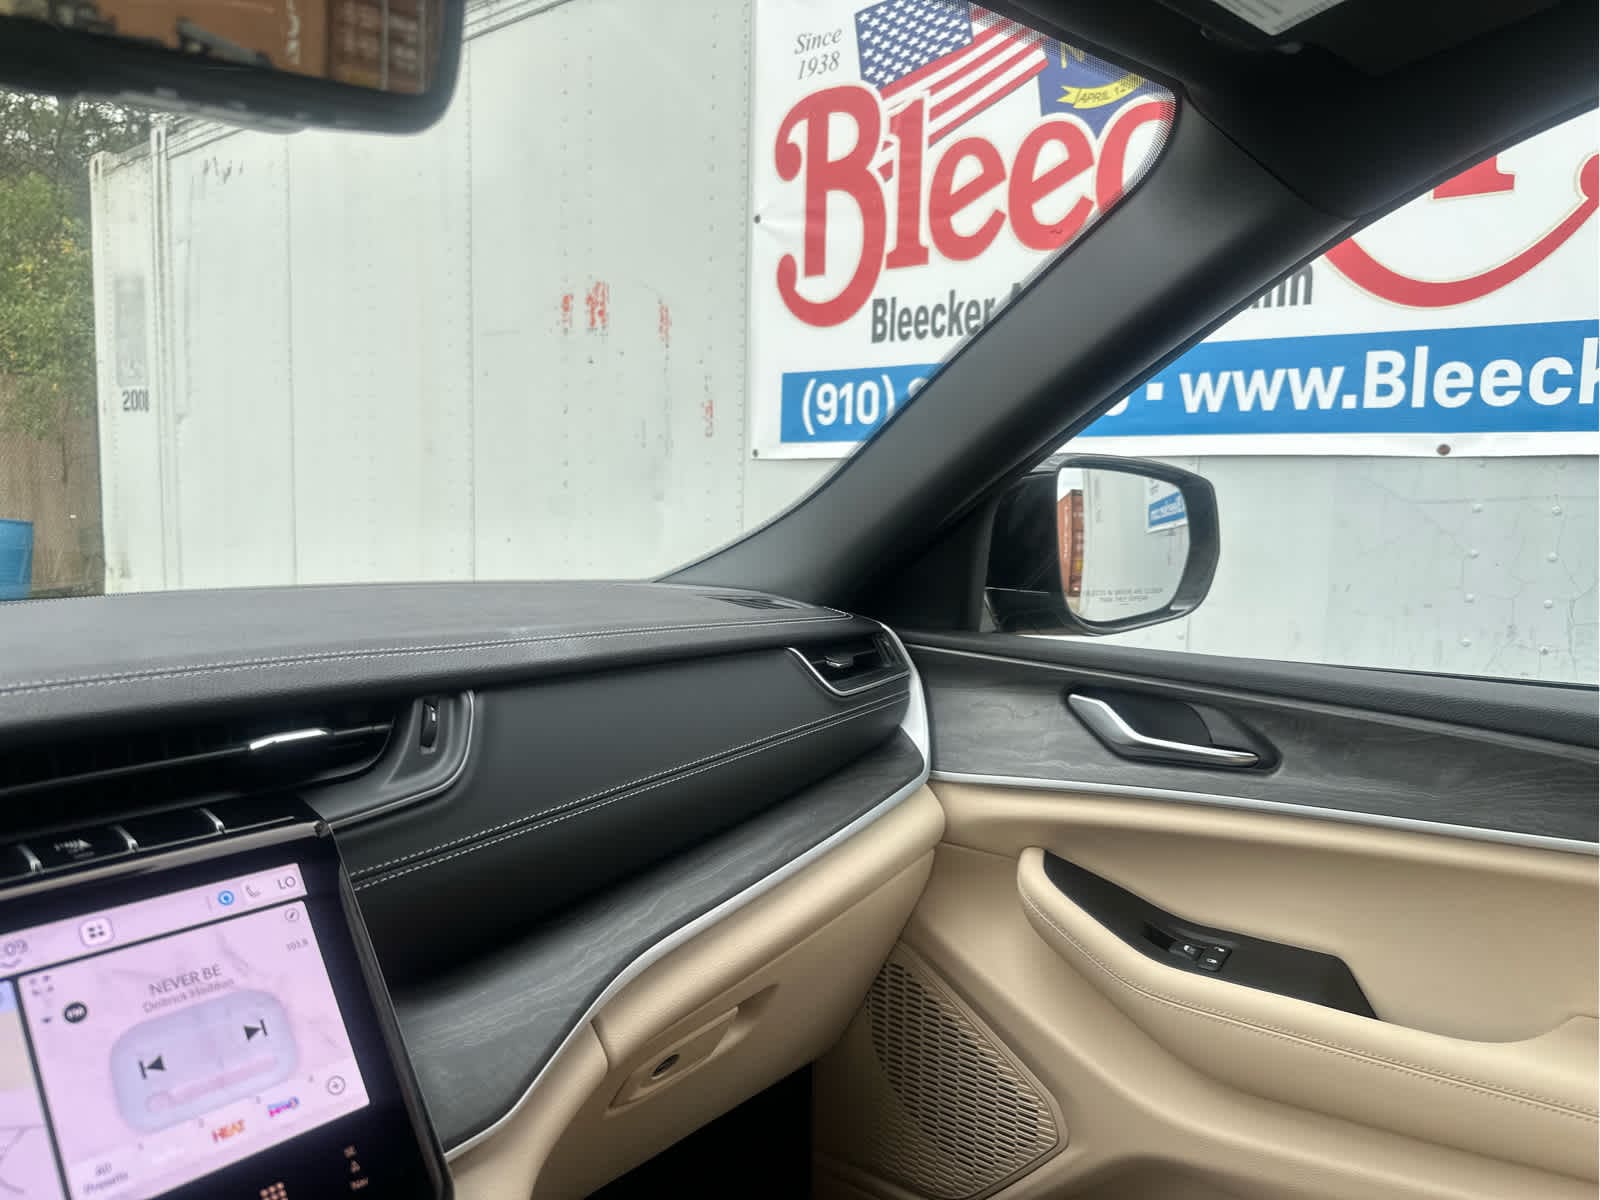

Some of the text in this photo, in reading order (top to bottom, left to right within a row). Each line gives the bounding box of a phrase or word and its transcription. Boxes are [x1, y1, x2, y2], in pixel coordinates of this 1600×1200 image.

[794, 28, 842, 54] Since
[797, 50, 841, 80] 1938
[871, 289, 996, 343] Bleecker
[802, 374, 895, 436] (910)
[277, 875, 297, 890] LO
[148, 962, 223, 995] NEVER BE
